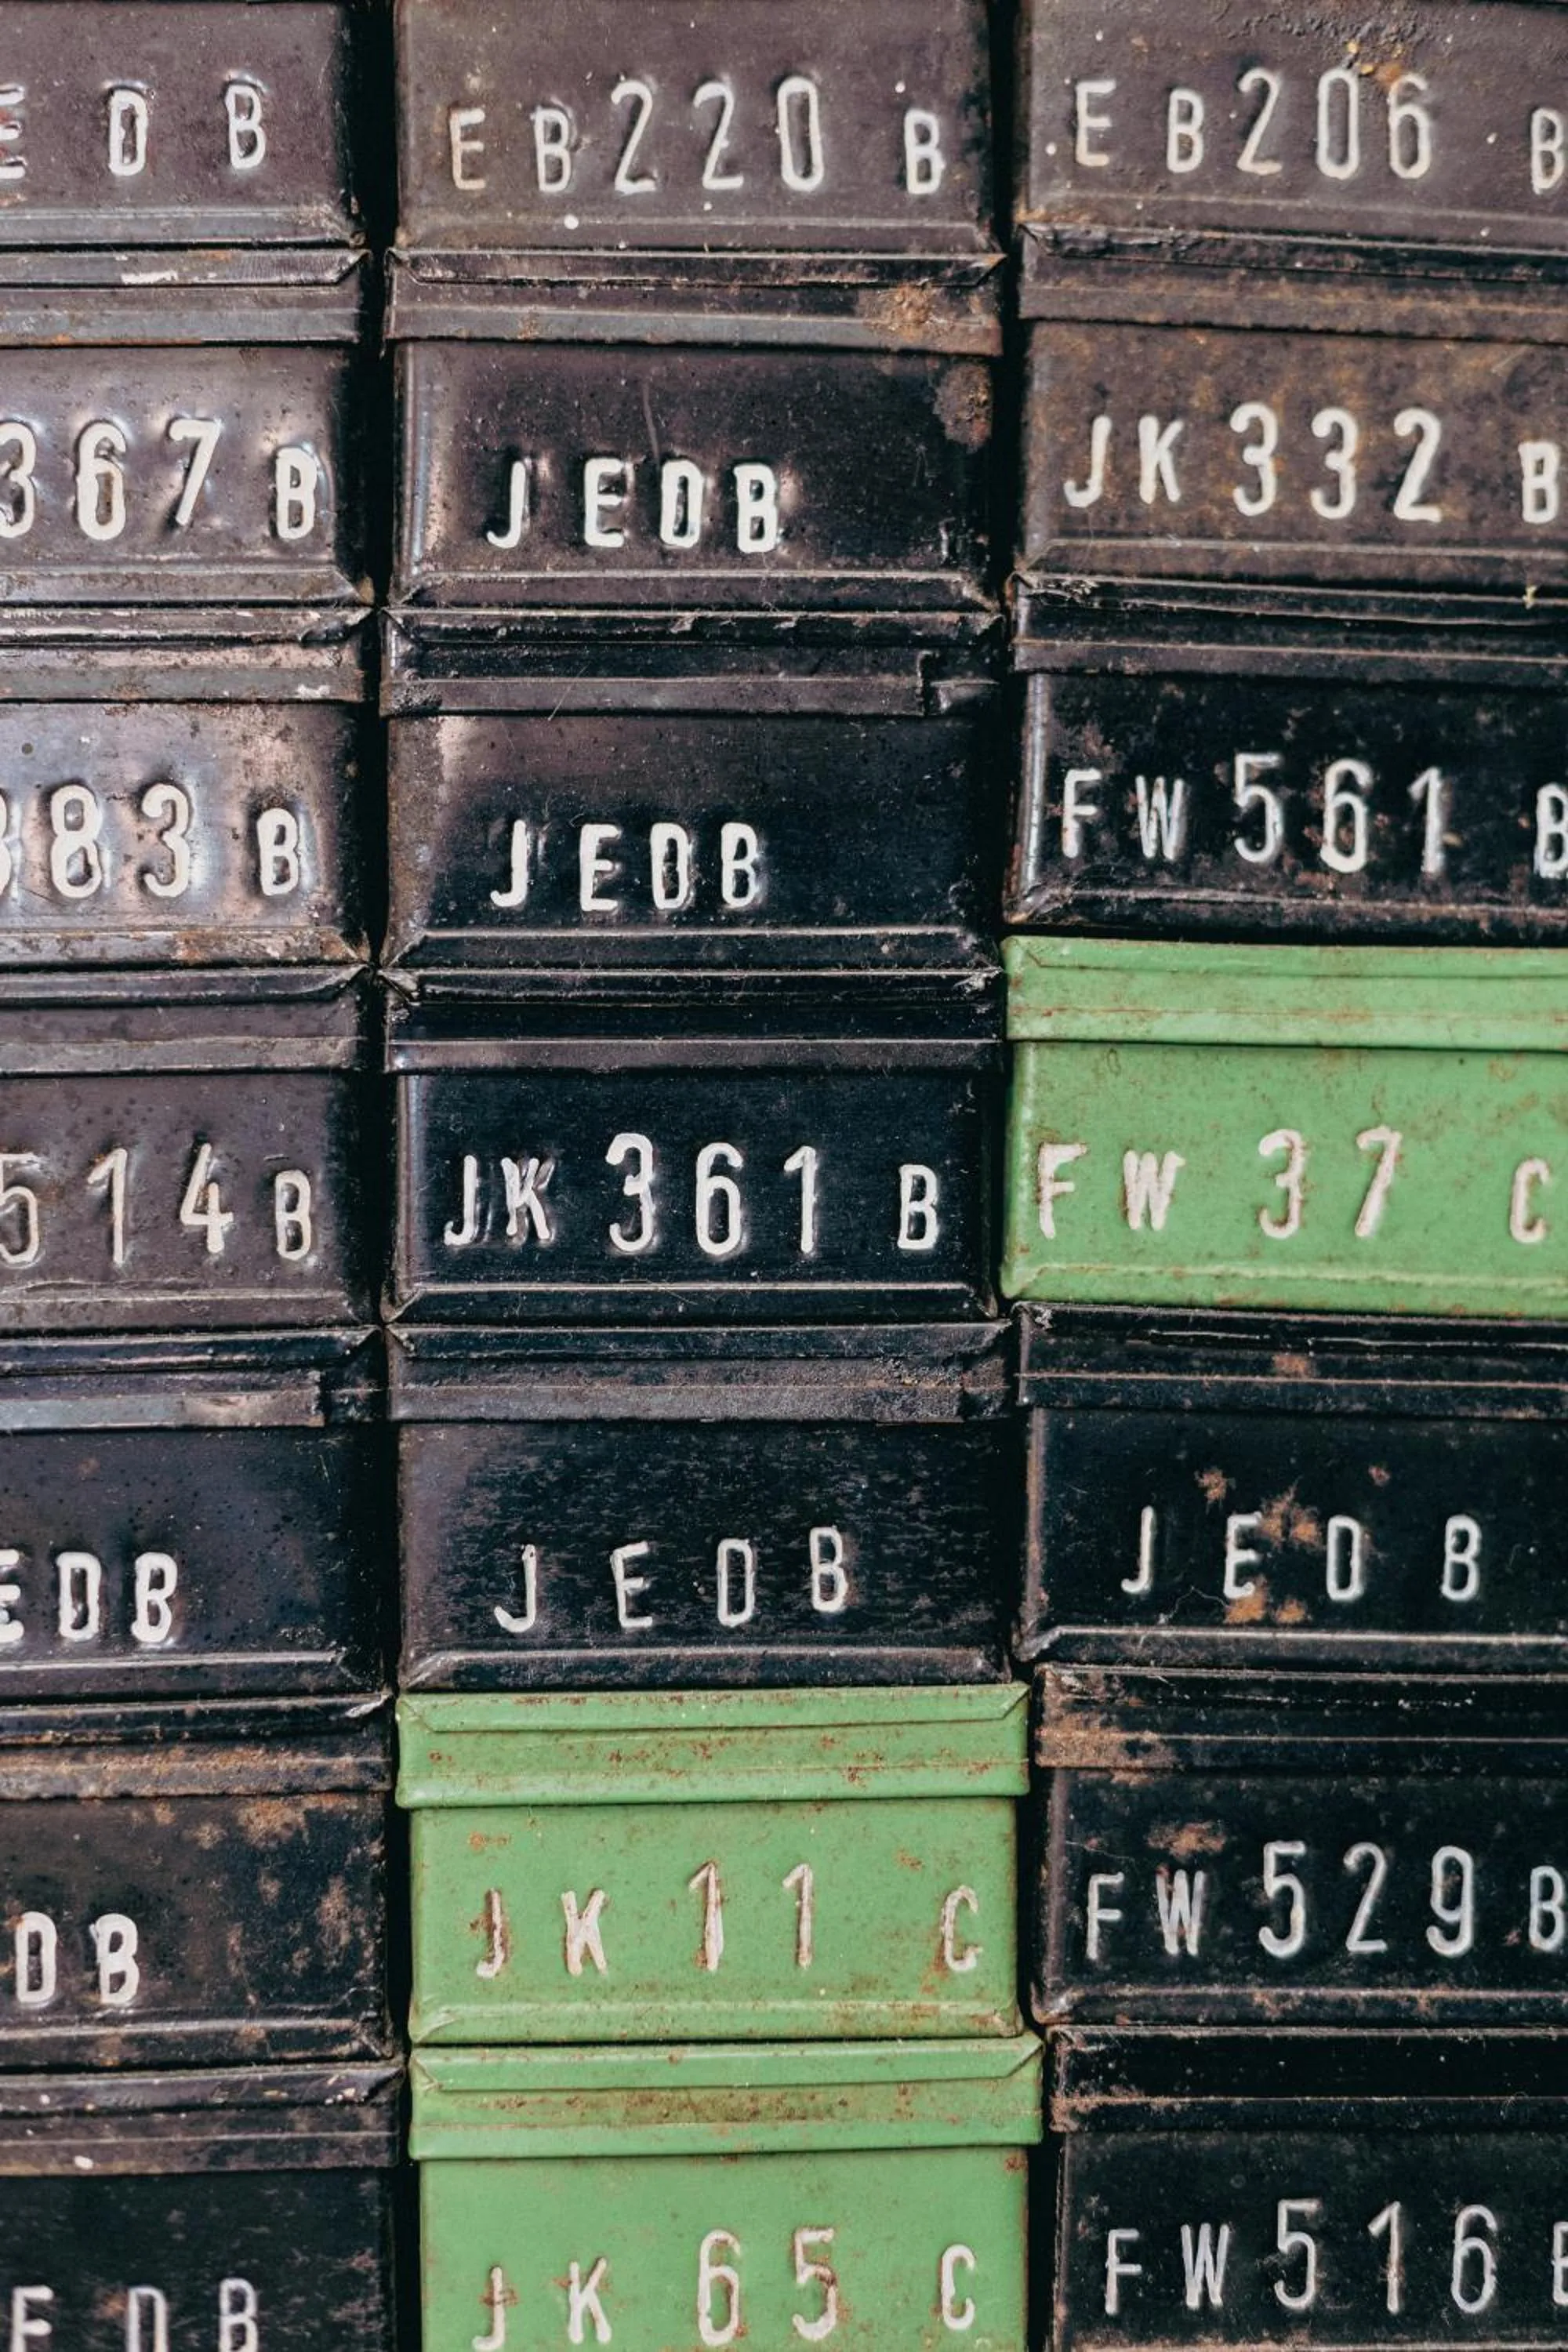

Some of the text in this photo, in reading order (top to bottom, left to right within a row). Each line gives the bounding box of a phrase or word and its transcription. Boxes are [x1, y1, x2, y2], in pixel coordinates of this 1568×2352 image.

[1518, 441, 1561, 524] B
[0, 784, 299, 898] 83 B
[274, 1170, 313, 1261] B
[898, 1163, 939, 1251] B
[1509, 1156, 1552, 1244] C
[941, 2244, 976, 2331] C
